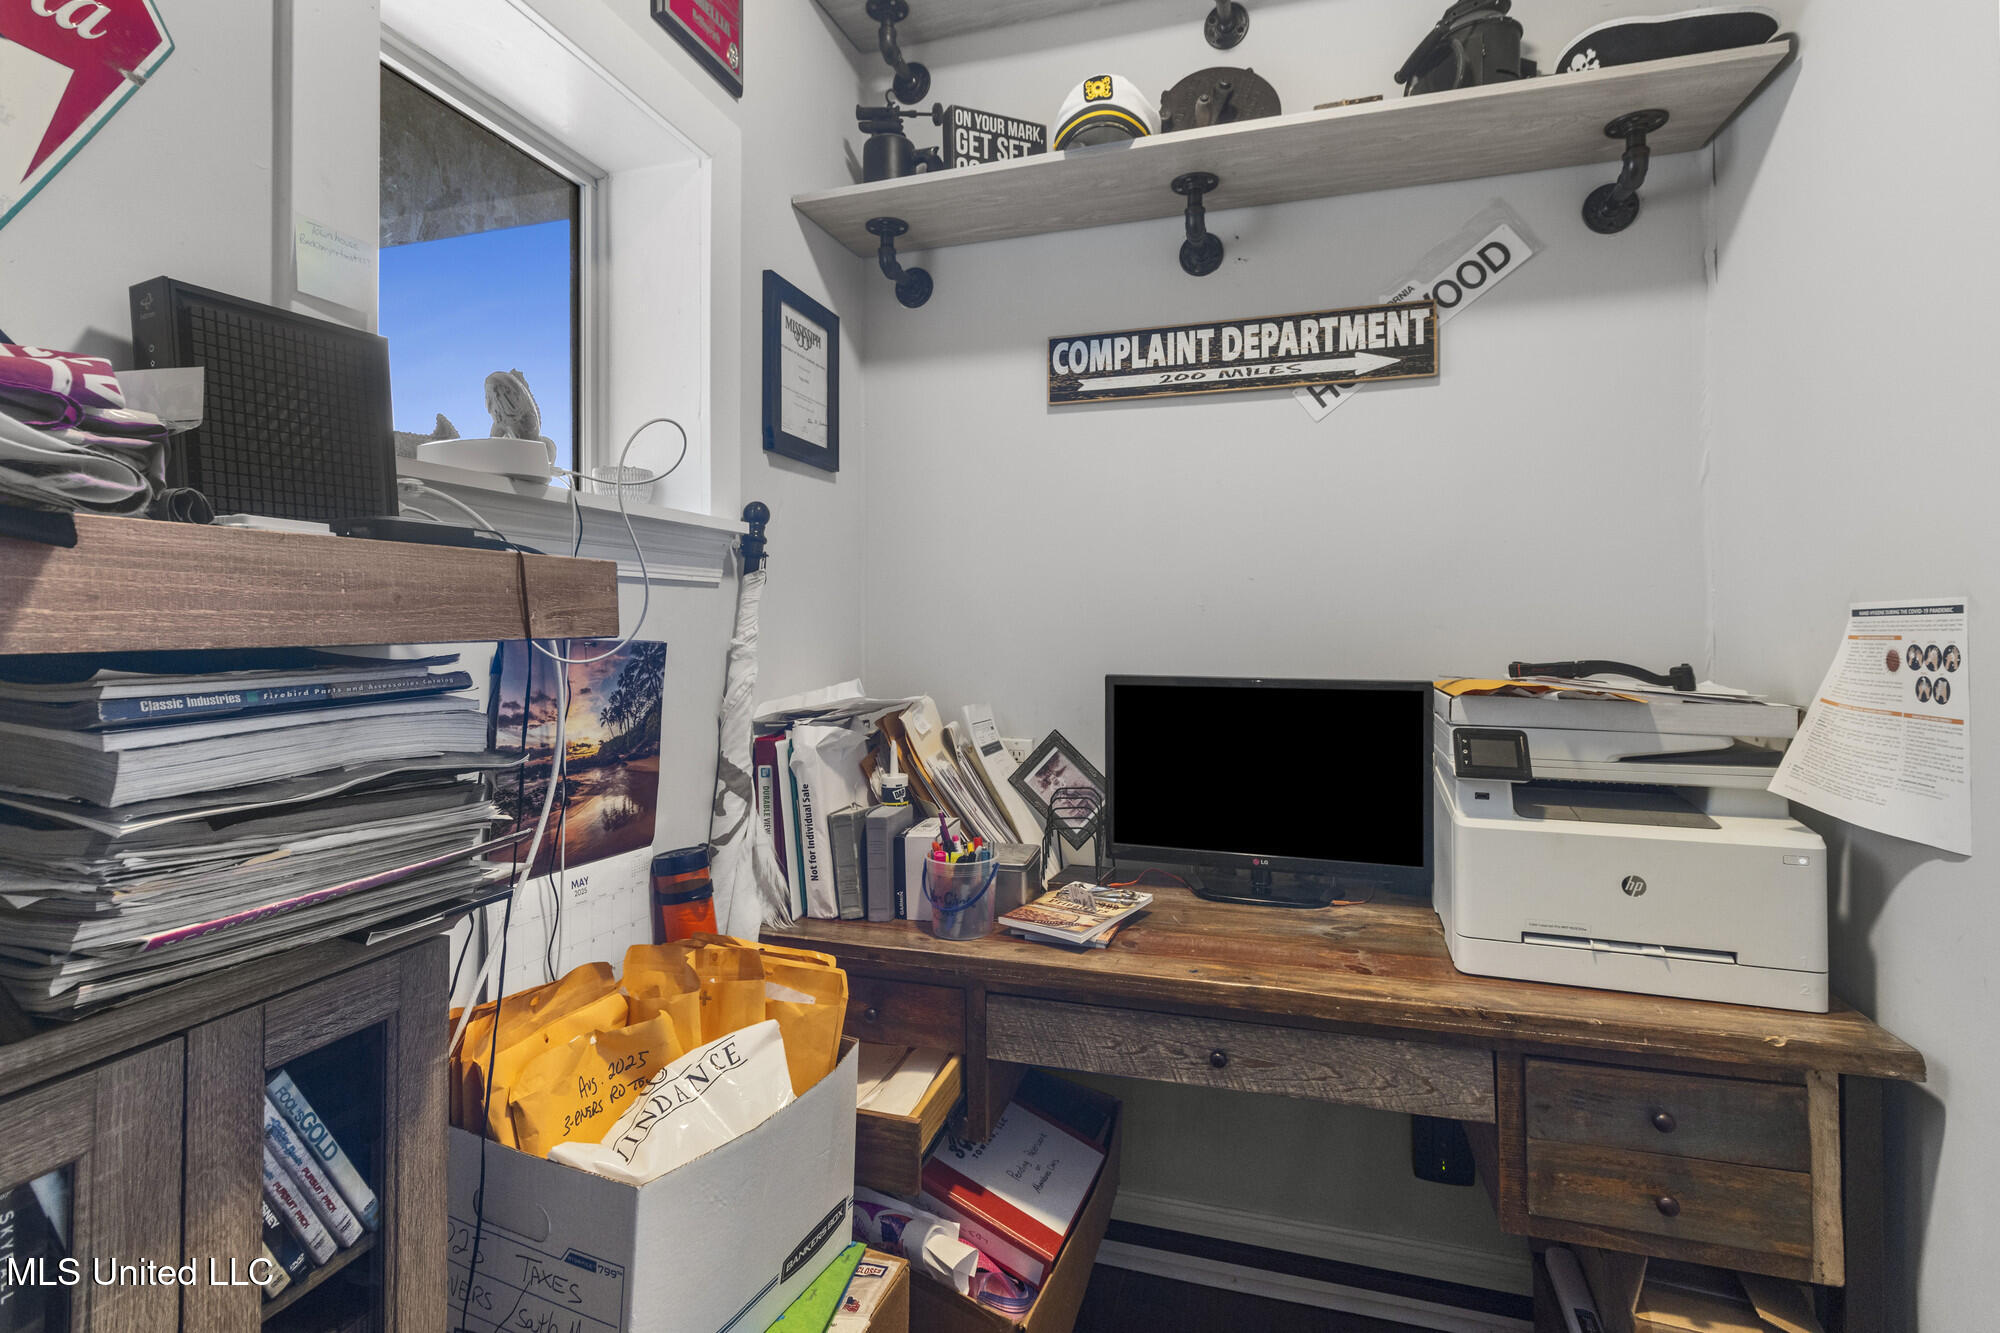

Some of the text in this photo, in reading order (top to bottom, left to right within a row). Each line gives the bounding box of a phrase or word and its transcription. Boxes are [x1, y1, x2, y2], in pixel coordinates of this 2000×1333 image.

[955, 109, 1044, 145] ON YOUR MARK,
[955, 128, 1031, 160] GET SET
[1053, 308, 1430, 376] COMPLAINT DEPARTMENT
[1159, 363, 1302, 384] 200 MILES
[140, 697, 184, 712] Classic
[186, 693, 241, 708] Industries
[263, 688, 310, 700] Firebird
[314, 685, 342, 694] Parts
[346, 684, 364, 692] and
[762, 785, 771, 835] DURABLE VIEW
[804, 804, 815, 850] Individual
[808, 851, 816, 866] for
[810, 866, 819, 881] Not
[571, 876, 589, 889] MAY
[574, 887, 588, 897] 2025
[1623, 875, 1645, 897] hp
[608, 1050, 650, 1079] 2025
[275, 1086, 304, 1122] FOOL'S
[299, 1111, 338, 1161] GOLD
[273, 1181, 297, 1210] PURSUIT
[294, 1210, 310, 1229] PACK
[302, 1167, 337, 1214] PURSUIT PACK
[786, 1208, 843, 1273] BANKERS BOX
[515, 1254, 583, 1304] TAXES
